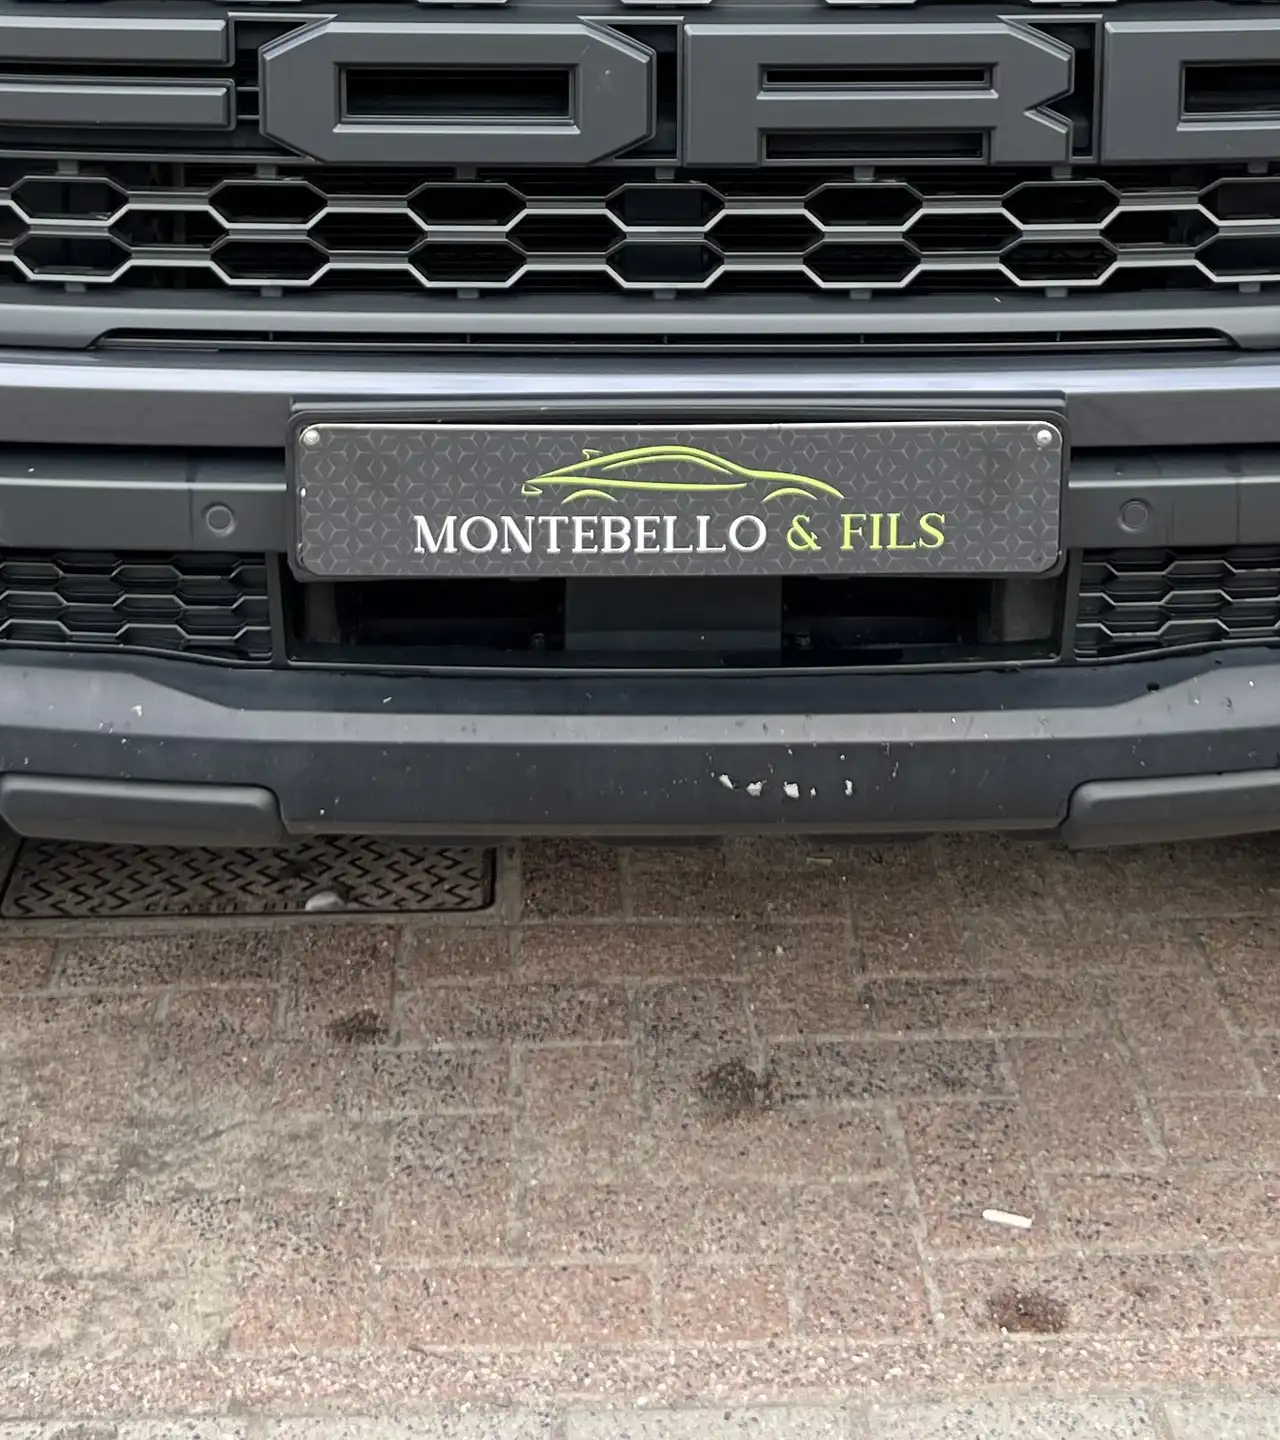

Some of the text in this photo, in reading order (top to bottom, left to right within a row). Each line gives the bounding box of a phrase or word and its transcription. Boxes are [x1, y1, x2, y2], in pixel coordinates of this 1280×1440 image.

[413, 512, 947, 556] MONTEBELLO & FILS
